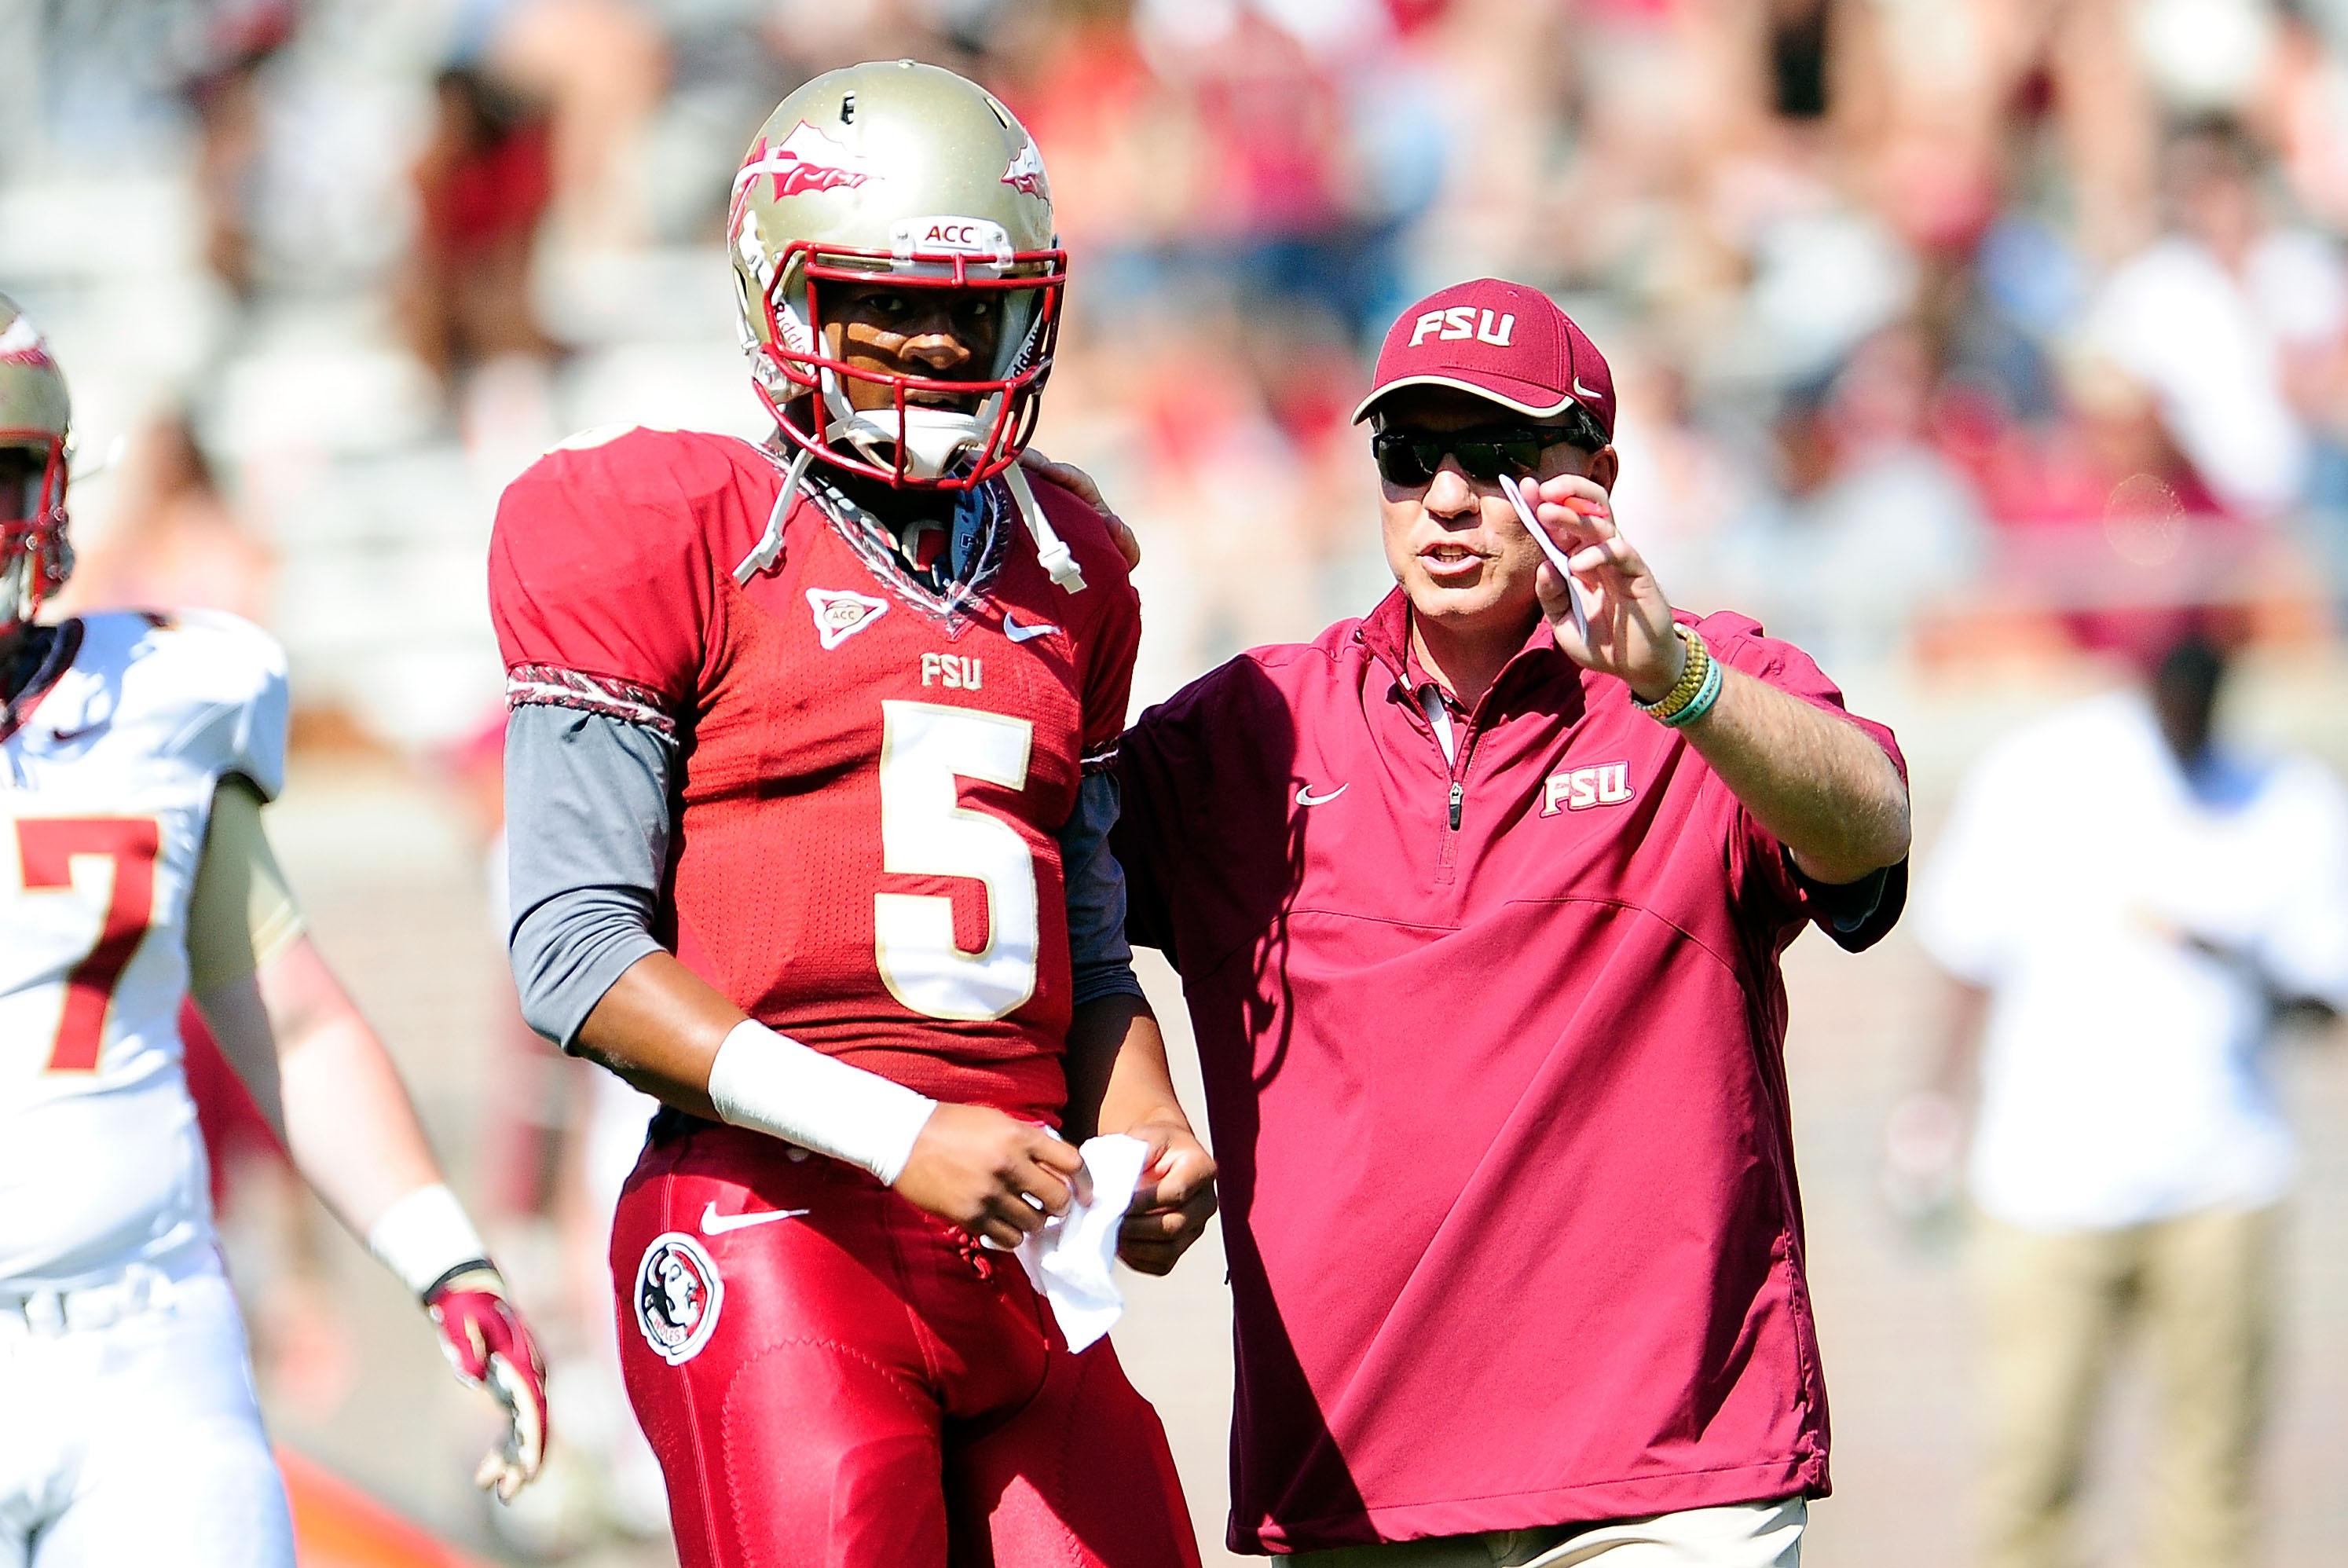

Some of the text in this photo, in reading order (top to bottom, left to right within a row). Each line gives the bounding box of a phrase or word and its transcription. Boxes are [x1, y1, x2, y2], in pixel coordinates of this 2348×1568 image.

[925, 225, 974, 244] ACC
[1408, 306, 1515, 347] FSU
[833, 610, 855, 620] ACC
[920, 652, 983, 691] FSU
[1540, 760, 1630, 818] FSU
[874, 699, 1038, 1021] 5
[13, 816, 160, 1075] 7
[654, 1317, 680, 1343] NOLES
